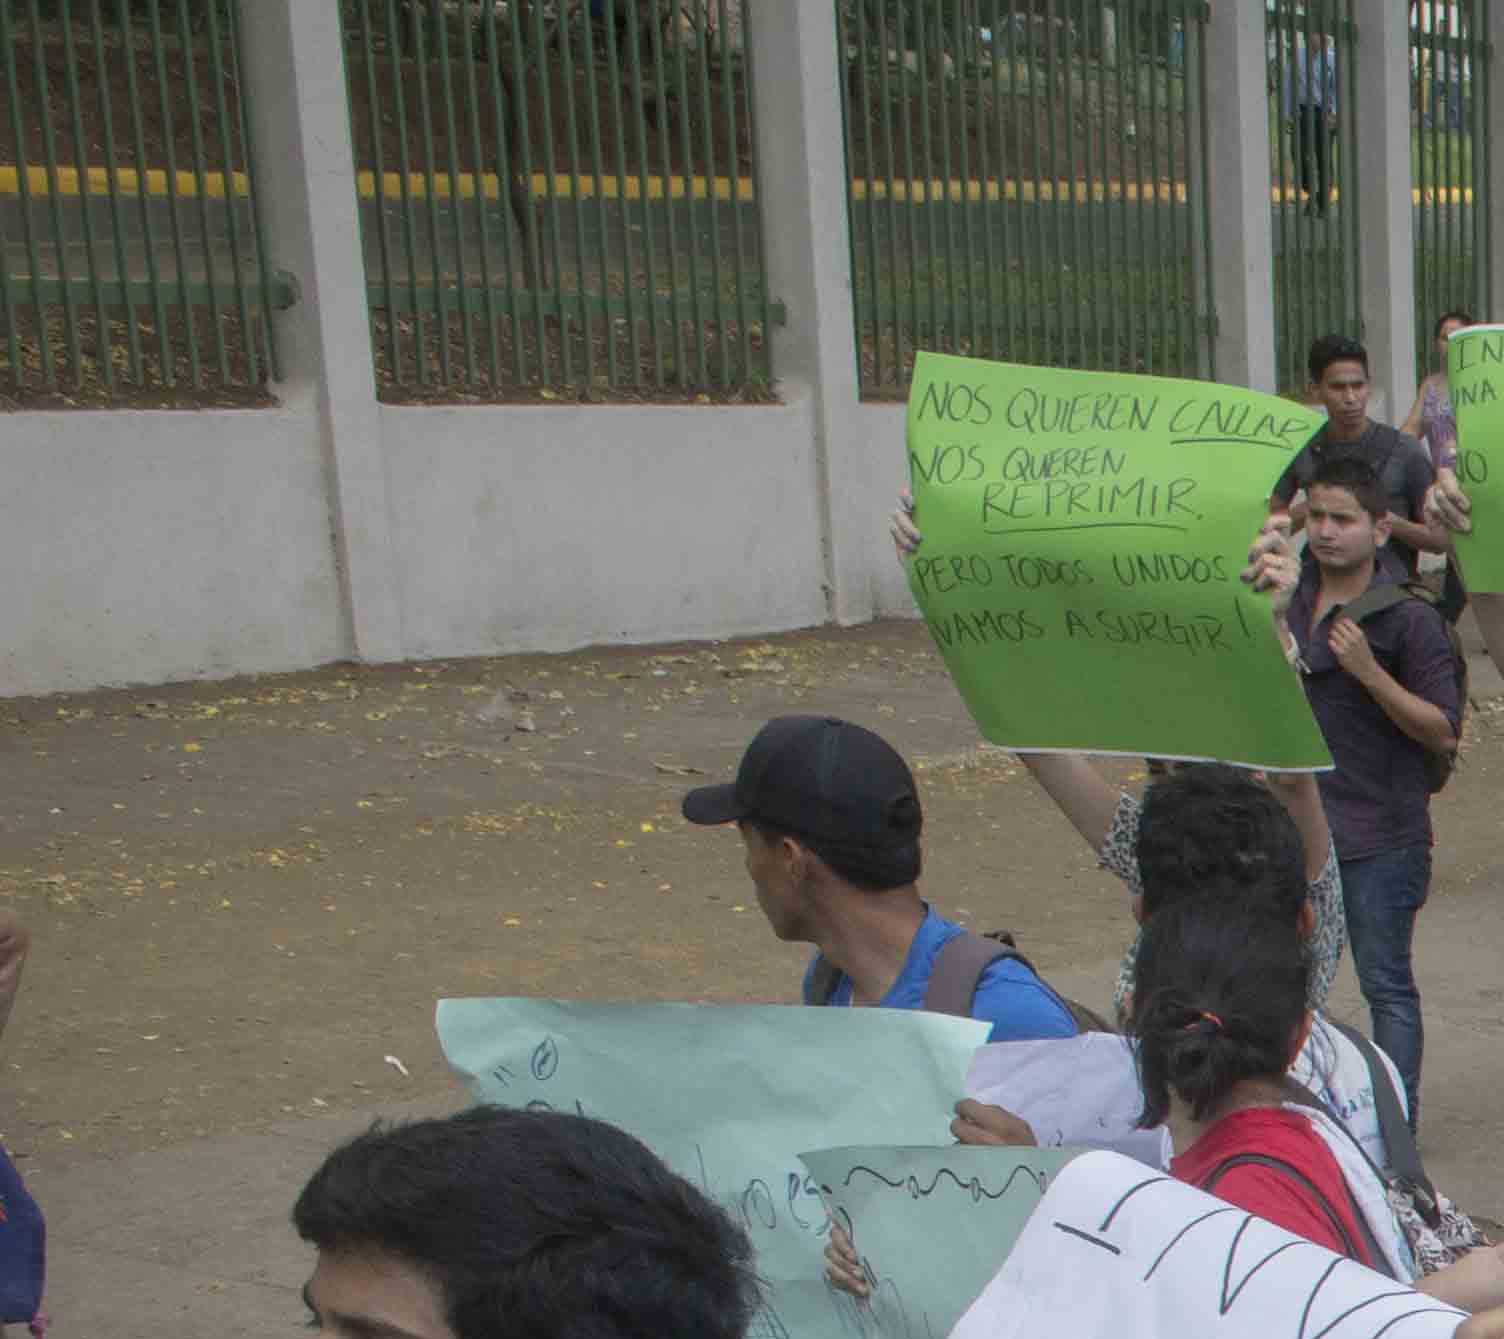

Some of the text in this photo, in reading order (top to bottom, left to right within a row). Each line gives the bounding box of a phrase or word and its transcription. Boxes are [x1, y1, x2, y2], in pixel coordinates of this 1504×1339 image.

[917, 381, 993, 425] NOS
[1006, 387, 1158, 435] QUIEREN
[911, 445, 986, 485] NOS
[915, 554, 1229, 594] PERO TODOS UNIDOS
[930, 609, 1045, 650] VAMOS
[1065, 607, 1094, 639] A
